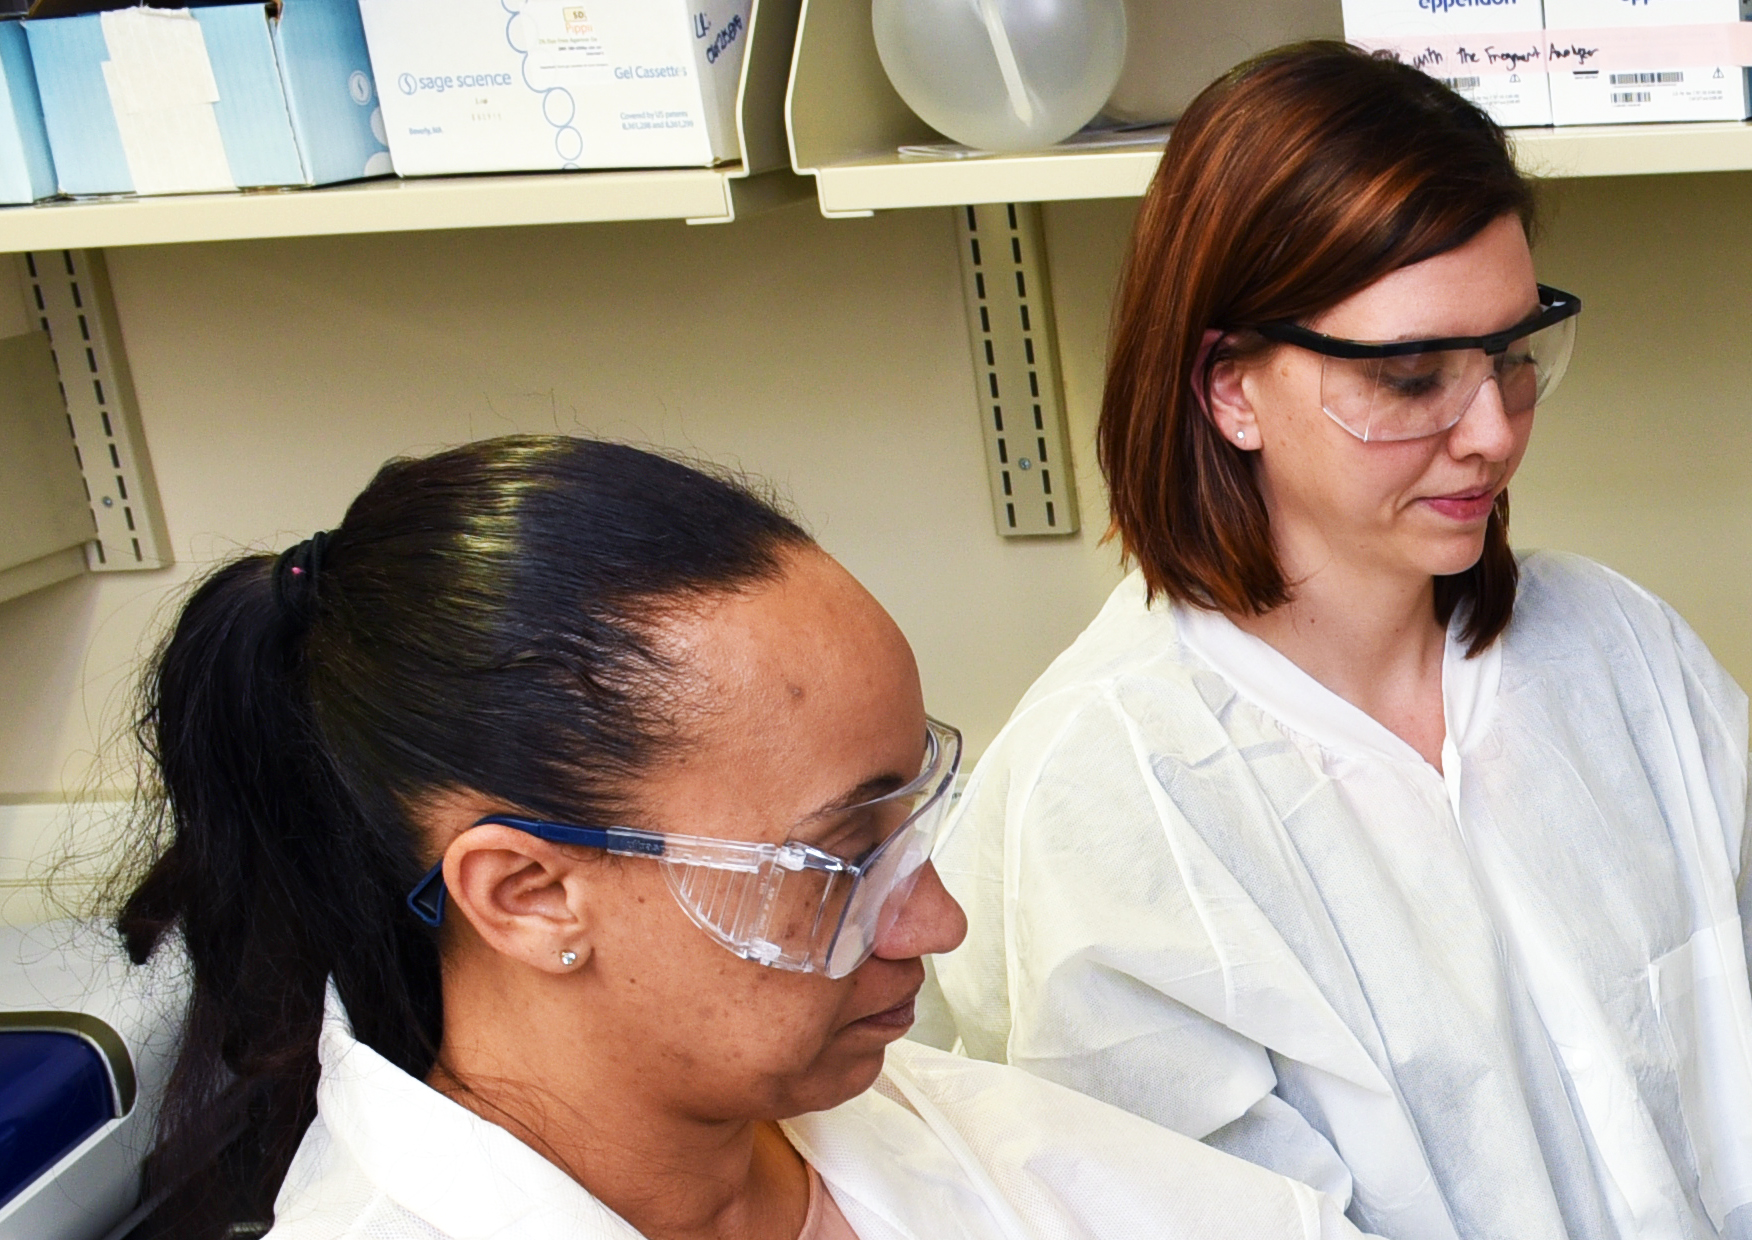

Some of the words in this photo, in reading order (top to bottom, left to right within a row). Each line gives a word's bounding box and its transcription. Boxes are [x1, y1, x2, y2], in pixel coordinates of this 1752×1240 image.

[1418, 0, 1517, 13] eppen
[614, 66, 633, 80] Gel
[419, 77, 453, 92] sage
[457, 73, 512, 88] science
